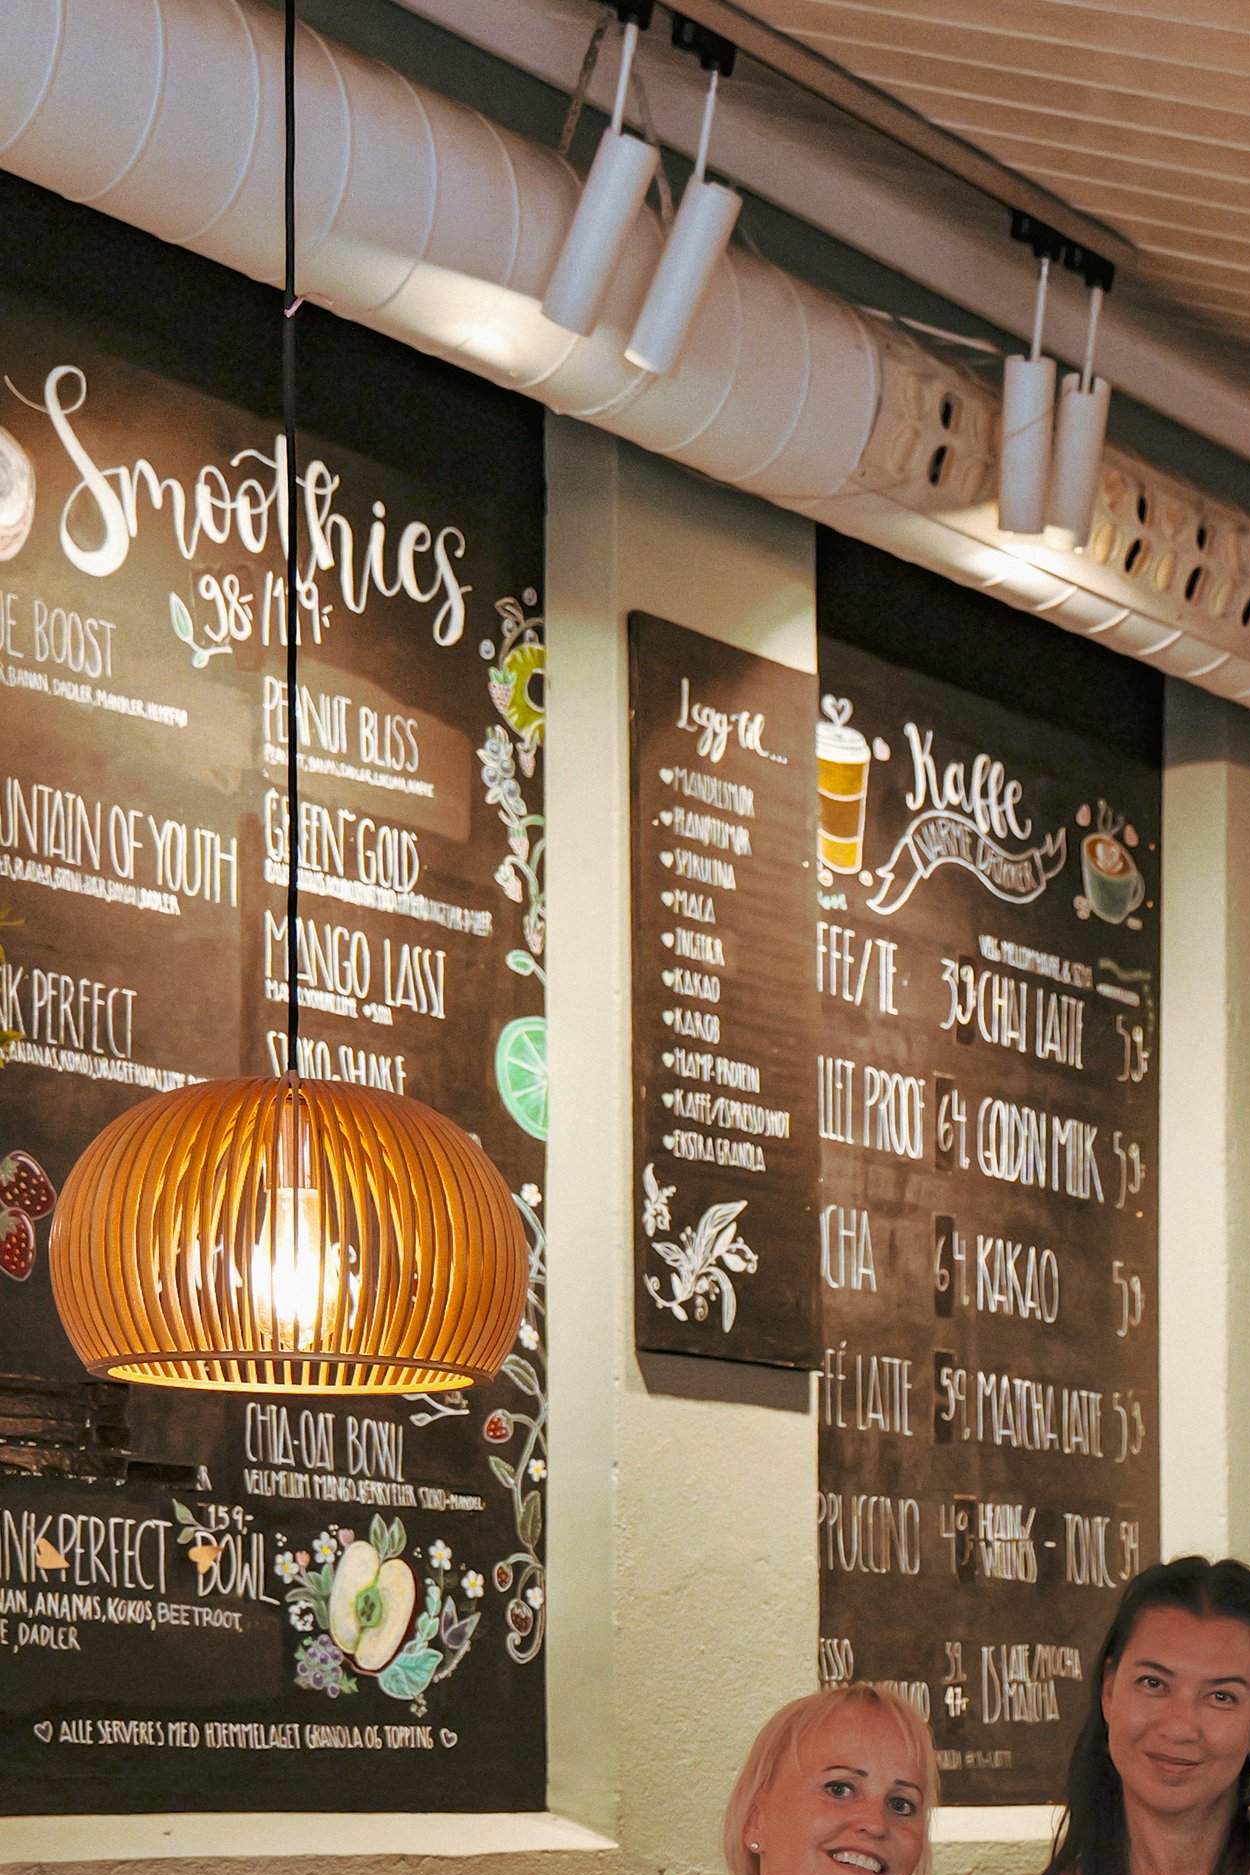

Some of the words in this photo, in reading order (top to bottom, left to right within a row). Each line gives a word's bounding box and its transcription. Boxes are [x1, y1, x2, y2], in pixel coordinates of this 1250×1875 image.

[5, 365, 472, 647] Smoothies
[34, 600, 117, 678] BOOST
[359, 705, 419, 774] BLISS
[676, 676, 734, 764] Legg
[903, 721, 1032, 840] Kaffe
[109, 805, 144, 880] OF
[147, 814, 238, 908] YOUTH
[357, 818, 420, 894] GOLD
[264, 909, 370, 999] MANGO
[672, 966, 721, 1004] KAKAO
[32, 968, 138, 1059] PERFECT
[977, 969, 1028, 1053] CHAI
[1035, 987, 1085, 1070] LATTE
[863, 1065, 926, 1160] PROOF
[976, 1233, 1060, 1324] KAKAO
[245, 1402, 336, 1472] CHIA-OAT
[346, 1415, 406, 1483] BOWL
[856, 1353, 914, 1438] LATTE
[976, 1370, 1060, 1450] MATCHA
[1062, 1387, 1104, 1458] LATTE
[58, 1513, 173, 1595] PERFECT
[192, 1530, 281, 1606] BOWL
[59, 1719, 94, 1745] ALLE
[97, 1719, 165, 1746] SERVERES
[167, 1721, 200, 1748] MED
[204, 1721, 300, 1750] HJEMMELAGET
[304, 1723, 364, 1750] GRANOLA
[364, 1724, 383, 1750] OG
[383, 1724, 434, 1750] TOPPING
